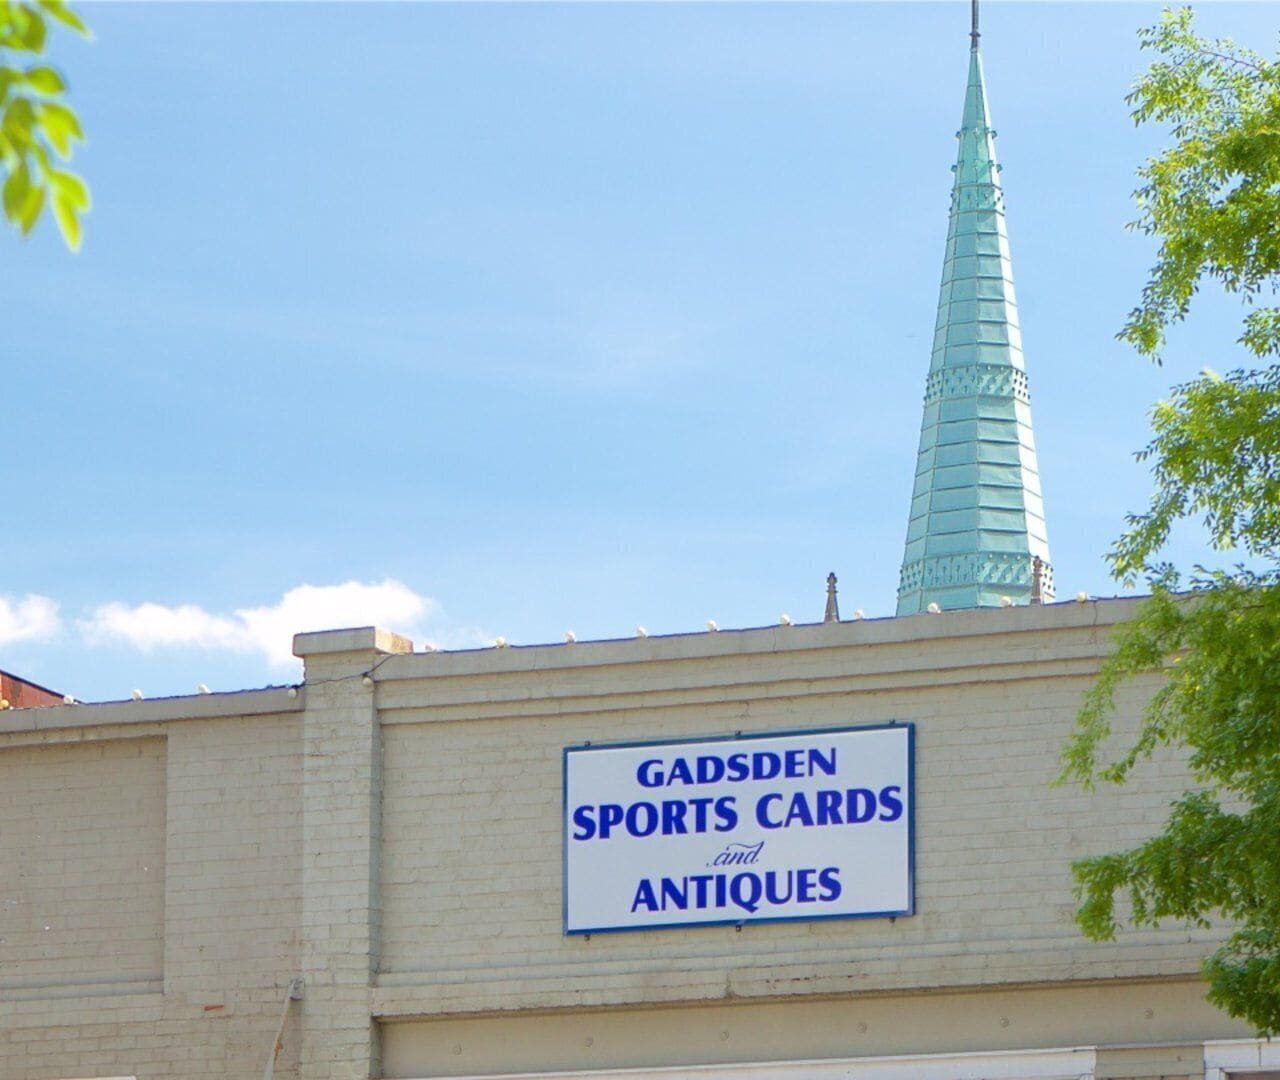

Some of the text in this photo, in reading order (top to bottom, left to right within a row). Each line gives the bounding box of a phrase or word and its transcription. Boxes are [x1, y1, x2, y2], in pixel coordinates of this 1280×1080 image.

[636, 747, 837, 788] GADSDEN
[572, 785, 903, 841] SPORTS CARDS
[708, 841, 765, 867] and
[630, 867, 843, 914] ANTIQUES
